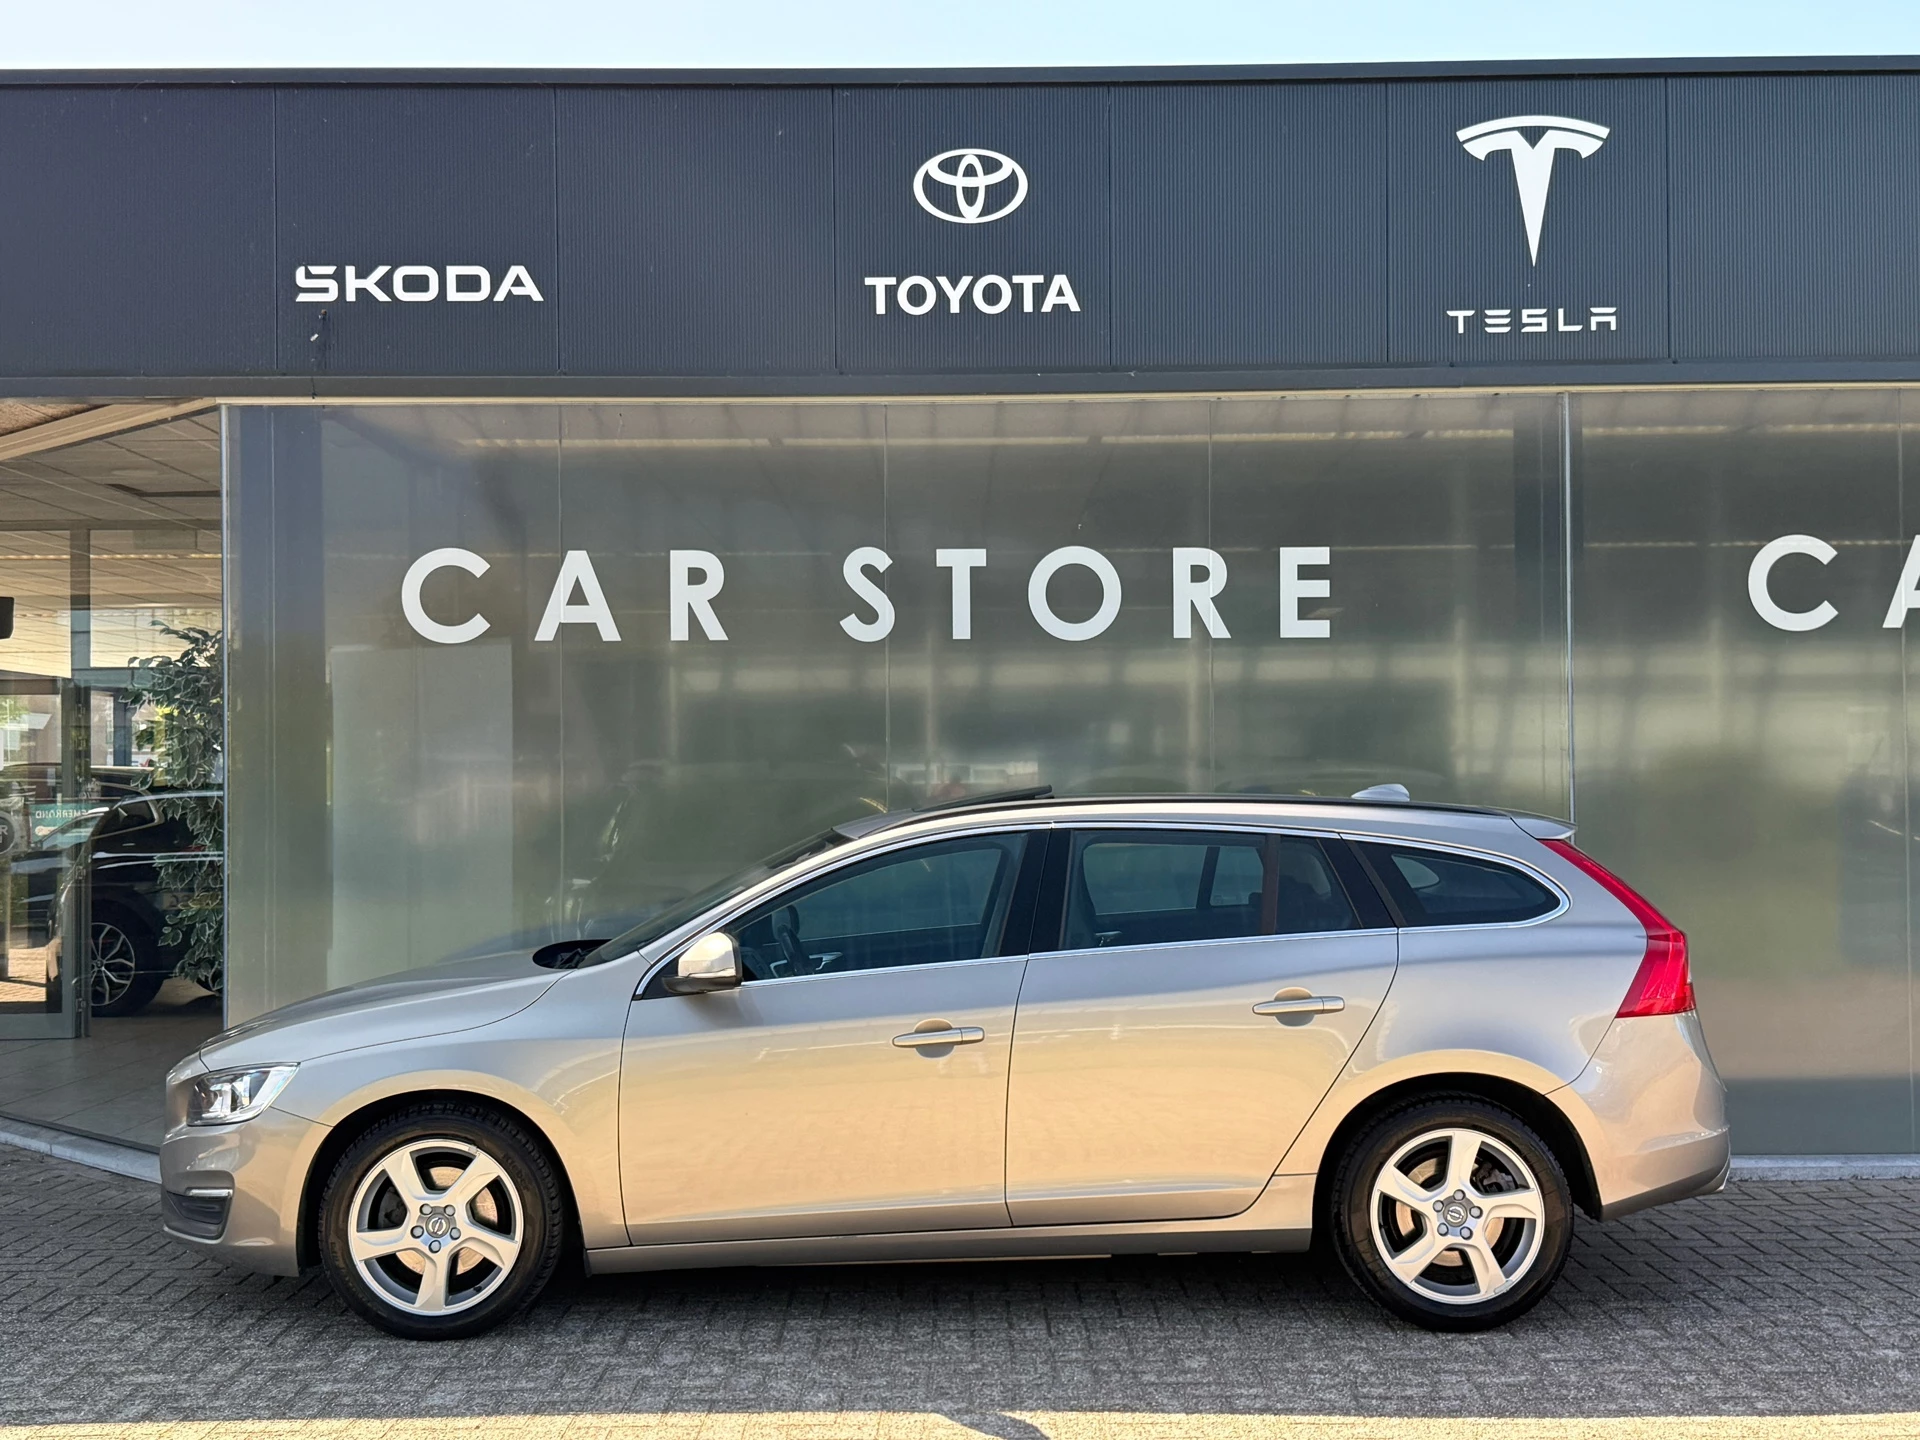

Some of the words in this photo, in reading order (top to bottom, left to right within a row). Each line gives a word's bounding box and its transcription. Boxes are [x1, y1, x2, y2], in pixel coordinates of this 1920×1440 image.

[295, 265, 544, 303] SKODA
[864, 274, 1081, 316] TOYOTA
[1446, 306, 1618, 334] TESLA
[402, 547, 728, 643] CAR
[839, 546, 1331, 642] STORE
